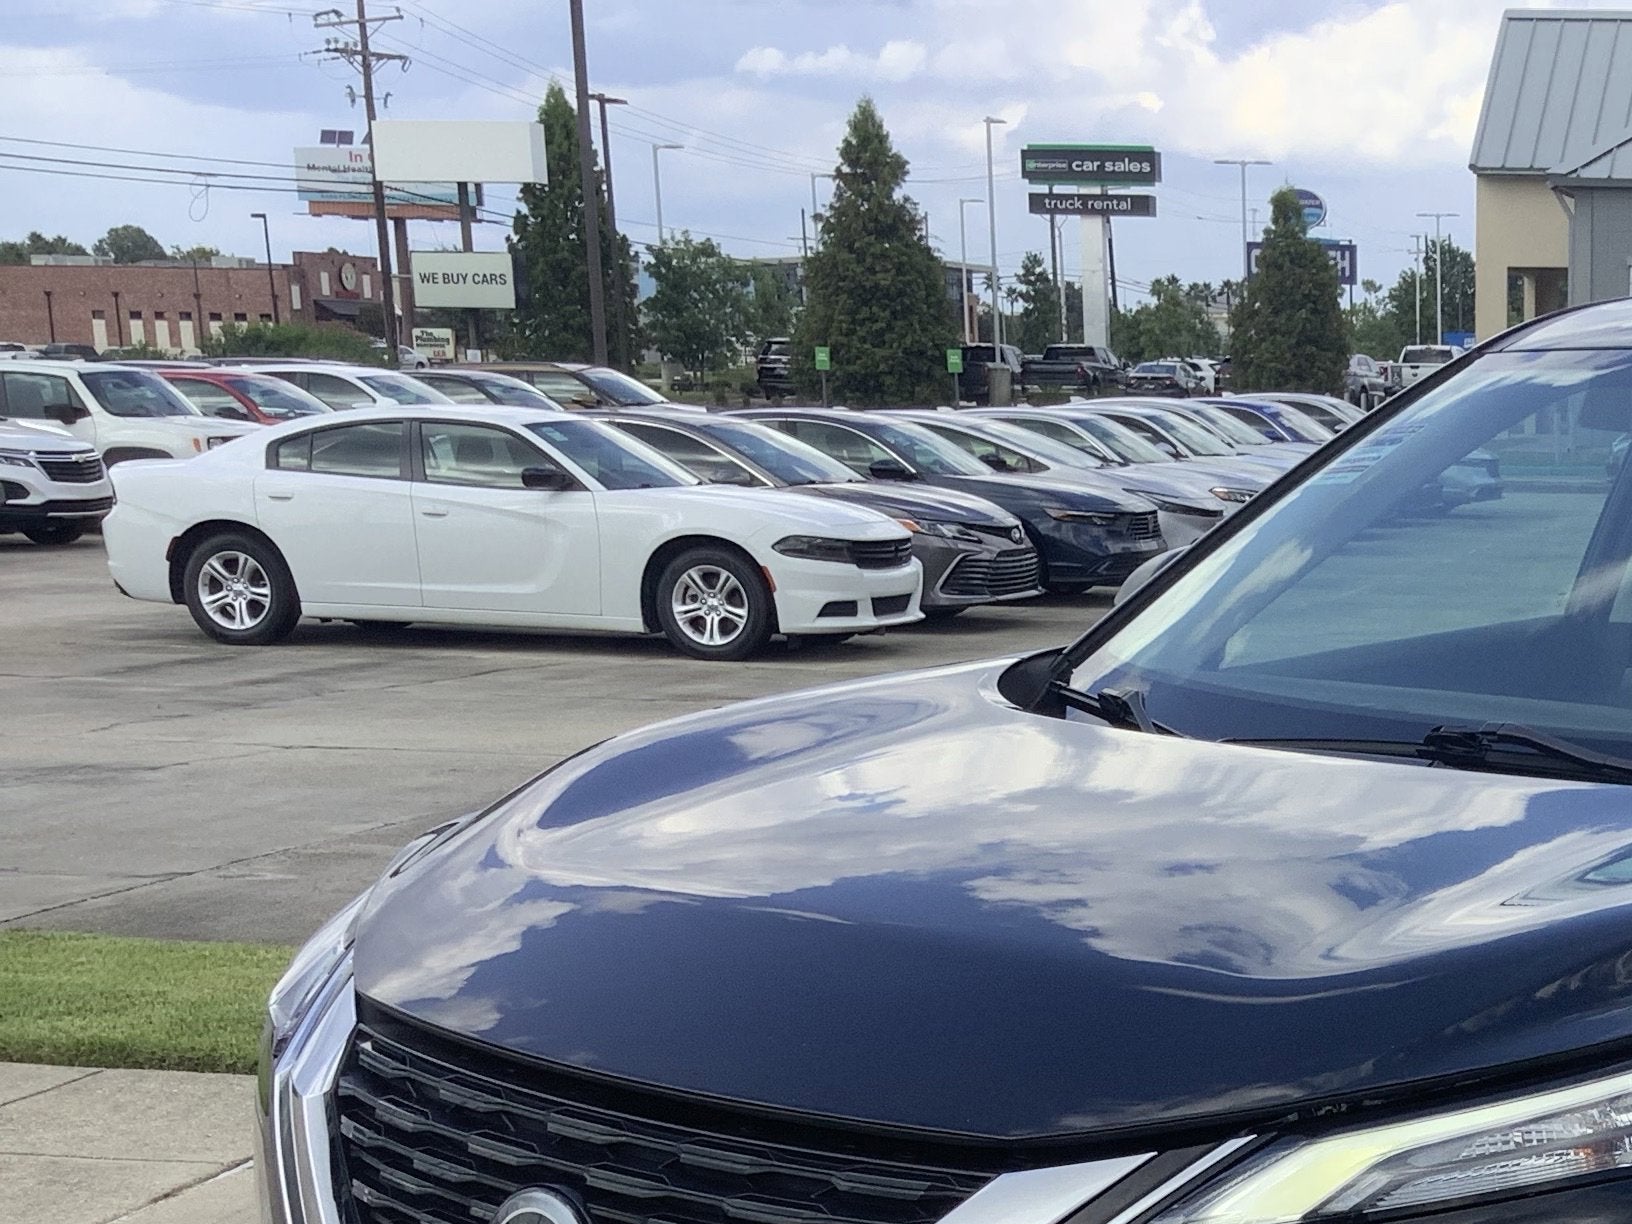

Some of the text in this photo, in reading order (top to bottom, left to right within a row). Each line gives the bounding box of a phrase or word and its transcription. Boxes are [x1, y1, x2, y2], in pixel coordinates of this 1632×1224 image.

[349, 150, 363, 162] In
[1072, 157, 1151, 172] car sales
[1044, 197, 1131, 210] truck rental
[419, 273, 507, 285] WE BUY CARS
